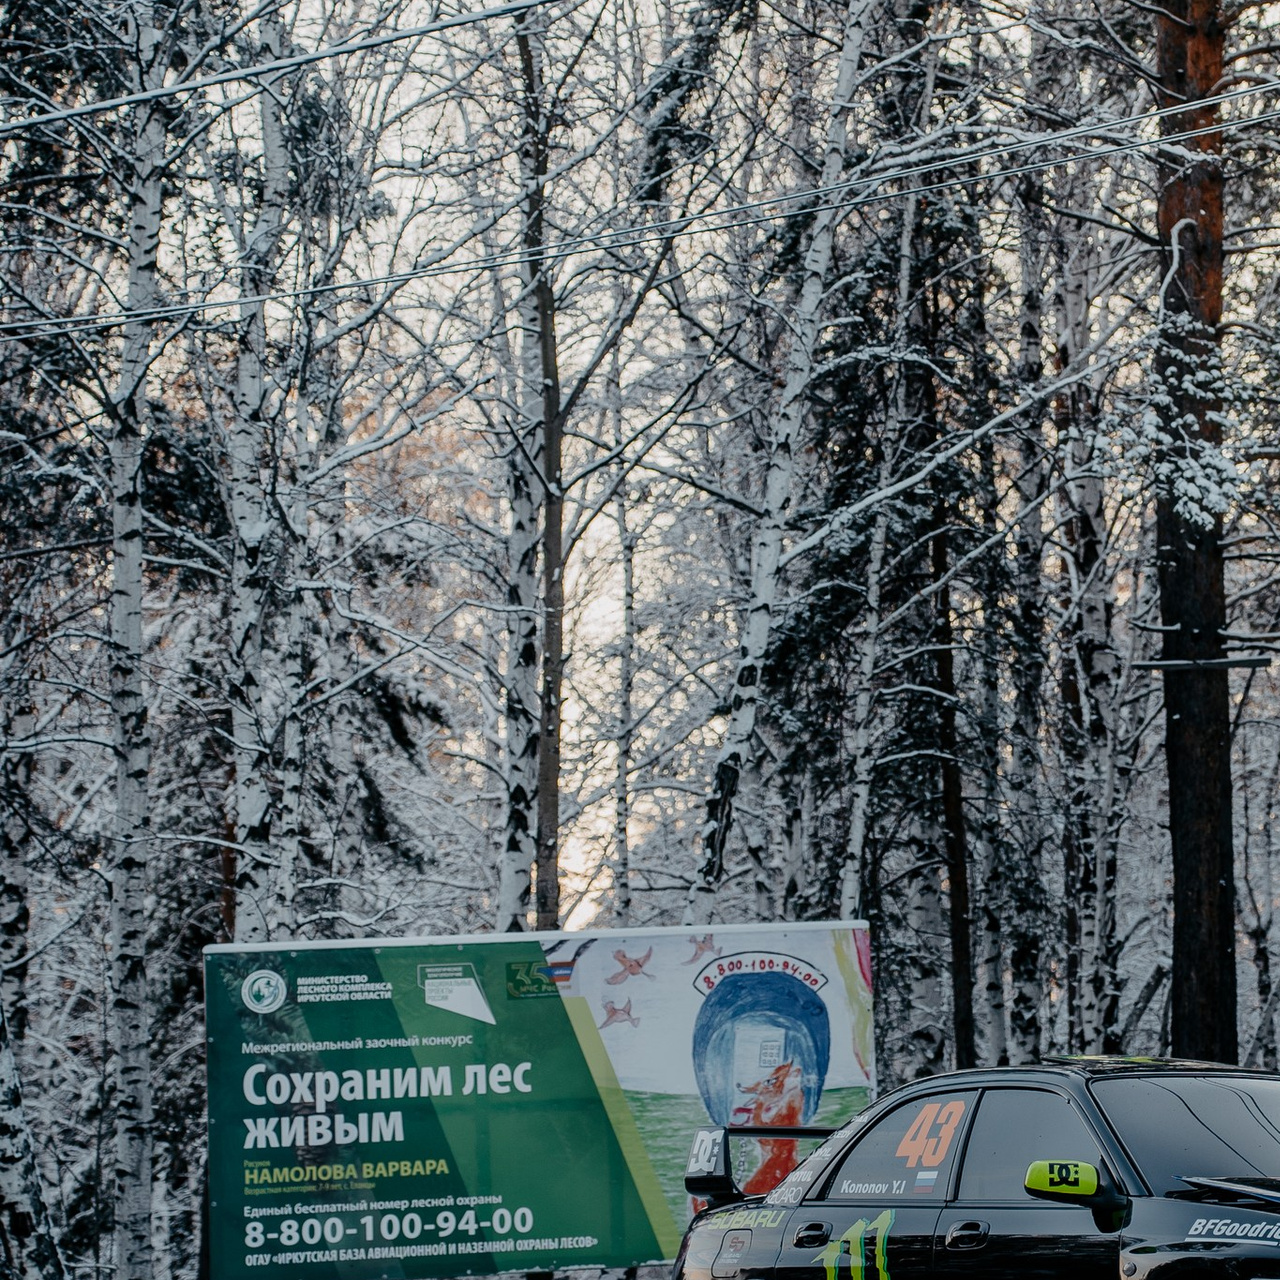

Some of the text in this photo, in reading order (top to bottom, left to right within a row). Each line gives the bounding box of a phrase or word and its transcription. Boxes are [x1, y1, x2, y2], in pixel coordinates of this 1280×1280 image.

[297, 975, 368, 985] МИНИСТЕРСТВО
[297, 982, 393, 994] ЛЕСНОГО КОМПЛЕКСА
[297, 990, 392, 1002] ИРКУТСКОЙ ОБЛАСТИ
[241, 1034, 473, 1055] Межрегиональный заочный конкурс
[243, 1062, 532, 1113] Сохраним лес
[243, 1111, 404, 1149] живым
[895, 1101, 966, 1168] 43
[244, 1159, 449, 1185] НАМОЛОВА ВАРВАРА
[841, 1180, 888, 1194] Kononov
[244, 1195, 502, 1218] Единый бесплатный номер лесной охраны
[244, 1207, 534, 1248] 8-800-100-94-00
[708, 1210, 786, 1229] SUBARU
[245, 1236, 598, 1266] ОГАУ «ИРКУТСКАЯ БАЗА АВИАЦИОННОЙ И НАЗЕМНОЙ ОХРАНЫ ЛЕСОВ»
